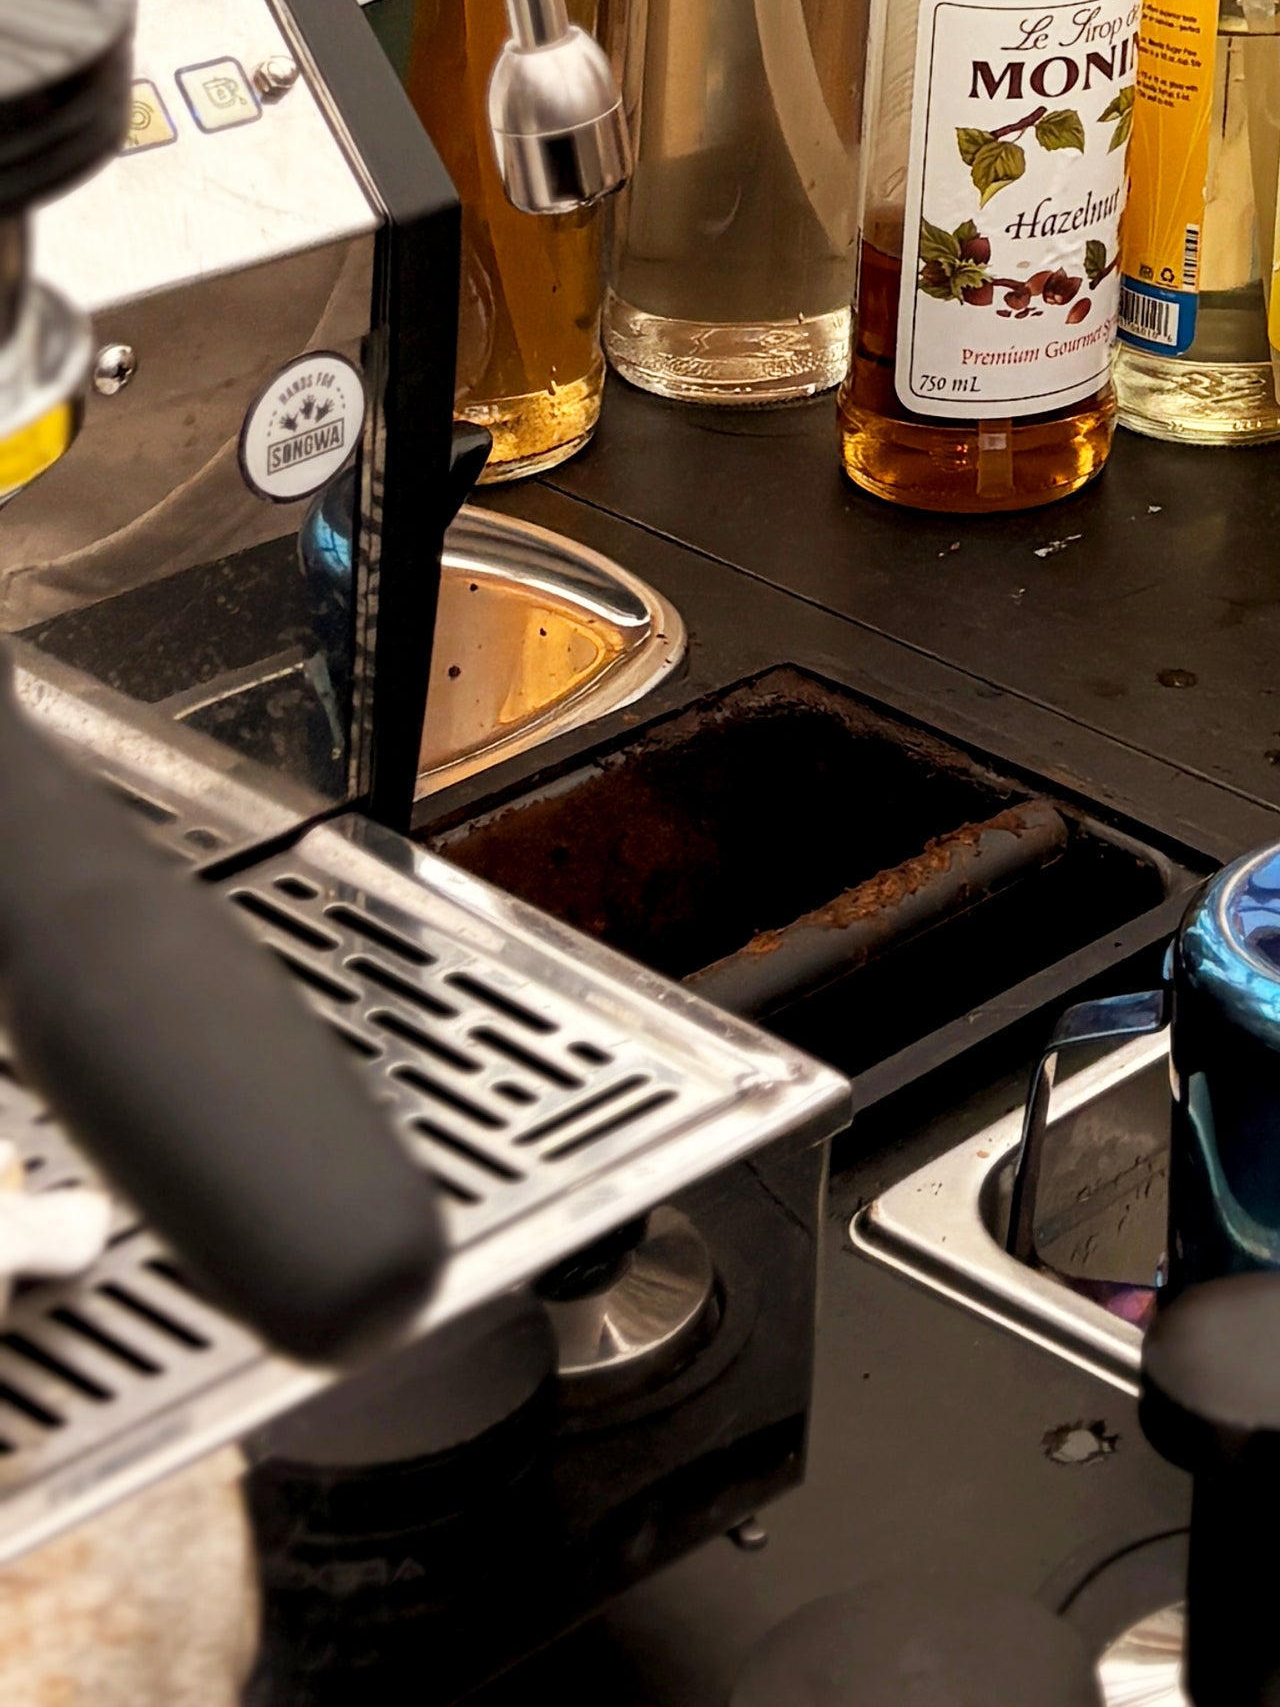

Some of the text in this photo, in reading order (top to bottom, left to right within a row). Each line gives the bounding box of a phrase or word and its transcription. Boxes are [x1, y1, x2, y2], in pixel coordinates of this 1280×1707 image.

[1000, 15, 1053, 50] Le
[1059, 6, 1123, 47] Sirop
[1005, 186, 1120, 239] Hazelnut
[961, 345, 1040, 366] Premium
[1045, 326, 1102, 360] Gourmet
[278, 371, 336, 405] HANDS FOR
[919, 375, 982, 393] 750 mL
[272, 425, 340, 468] SONGWA
